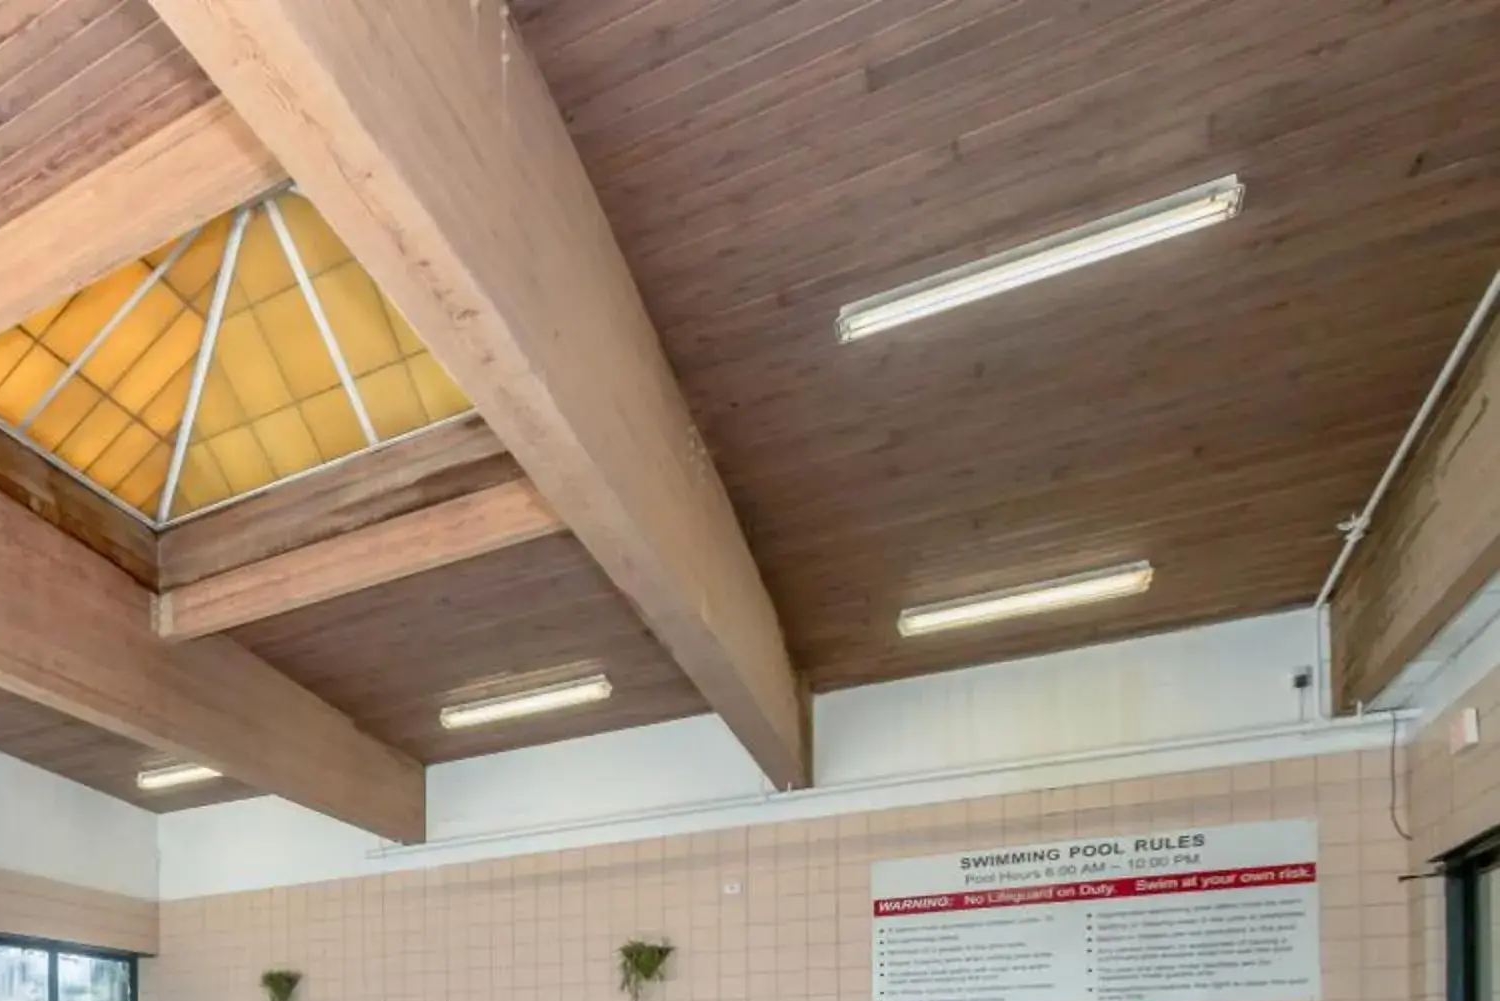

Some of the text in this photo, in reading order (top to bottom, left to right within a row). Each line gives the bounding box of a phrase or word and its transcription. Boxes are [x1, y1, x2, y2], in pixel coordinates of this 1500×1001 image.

[960, 833, 1205, 869] SWIMMING POOL RULES
[964, 872, 996, 885] Pool
[999, 869, 1041, 882] Hours
[1080, 861, 1106, 874] AM
[1173, 853, 1201, 865] PM
[963, 894, 985, 906] No
[1056, 887, 1076, 898] on
[1134, 878, 1179, 892] Swim
[1181, 875, 1199, 888] at
[1201, 872, 1238, 890] your
[1240, 871, 1275, 883] own
